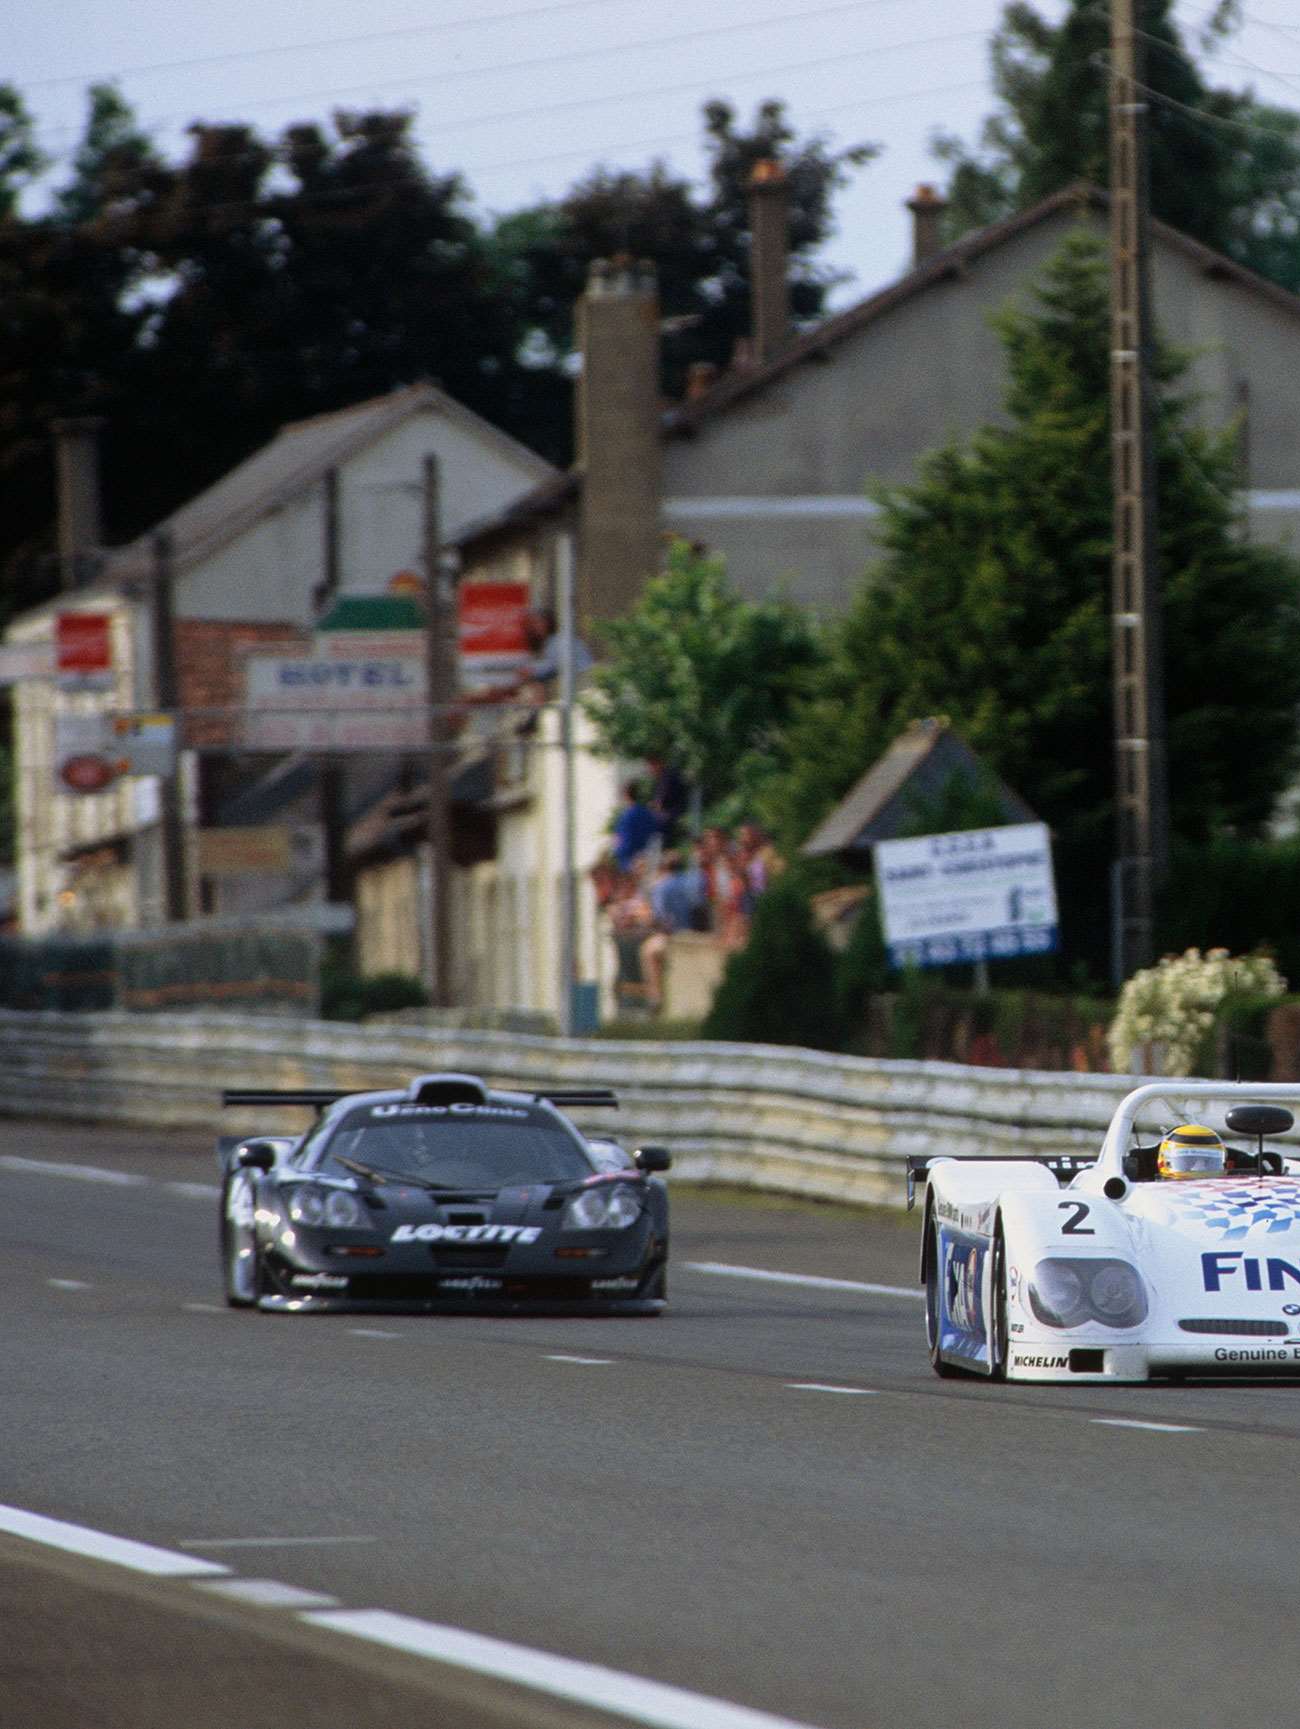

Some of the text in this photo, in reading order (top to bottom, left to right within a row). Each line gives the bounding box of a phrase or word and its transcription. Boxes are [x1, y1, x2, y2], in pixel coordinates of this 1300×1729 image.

[1058, 1201, 1095, 1235] 2
[390, 1223, 544, 1244] LOCTITE
[1014, 1355, 1069, 1368] MICHELIN
[1214, 1347, 1288, 1361] Genuine
